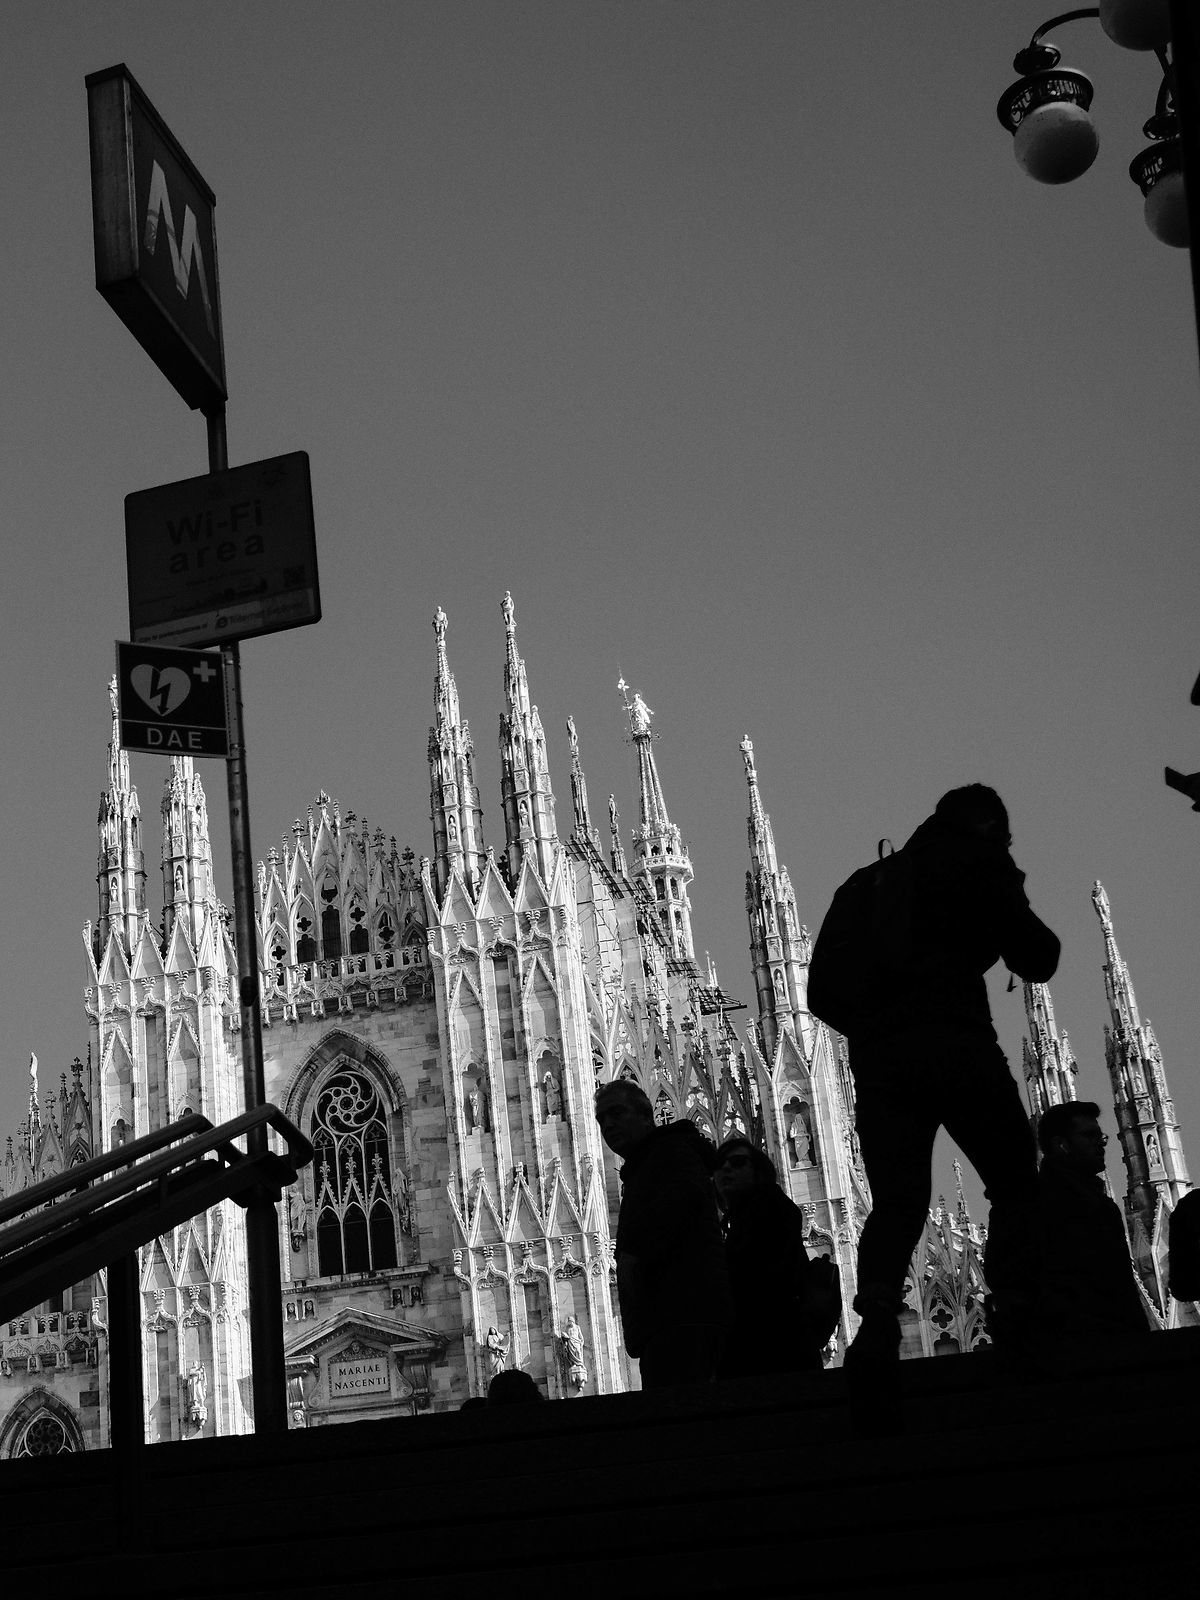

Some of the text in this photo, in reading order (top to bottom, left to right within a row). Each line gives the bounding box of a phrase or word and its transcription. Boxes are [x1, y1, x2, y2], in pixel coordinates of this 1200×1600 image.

[143, 159, 216, 341] M
[167, 499, 263, 546] Wi-Fi
[169, 534, 265, 574] area
[146, 727, 203, 750] DAE
[335, 1377, 386, 1390] NASCENTI
[339, 1364, 380, 1376] MARIAE
